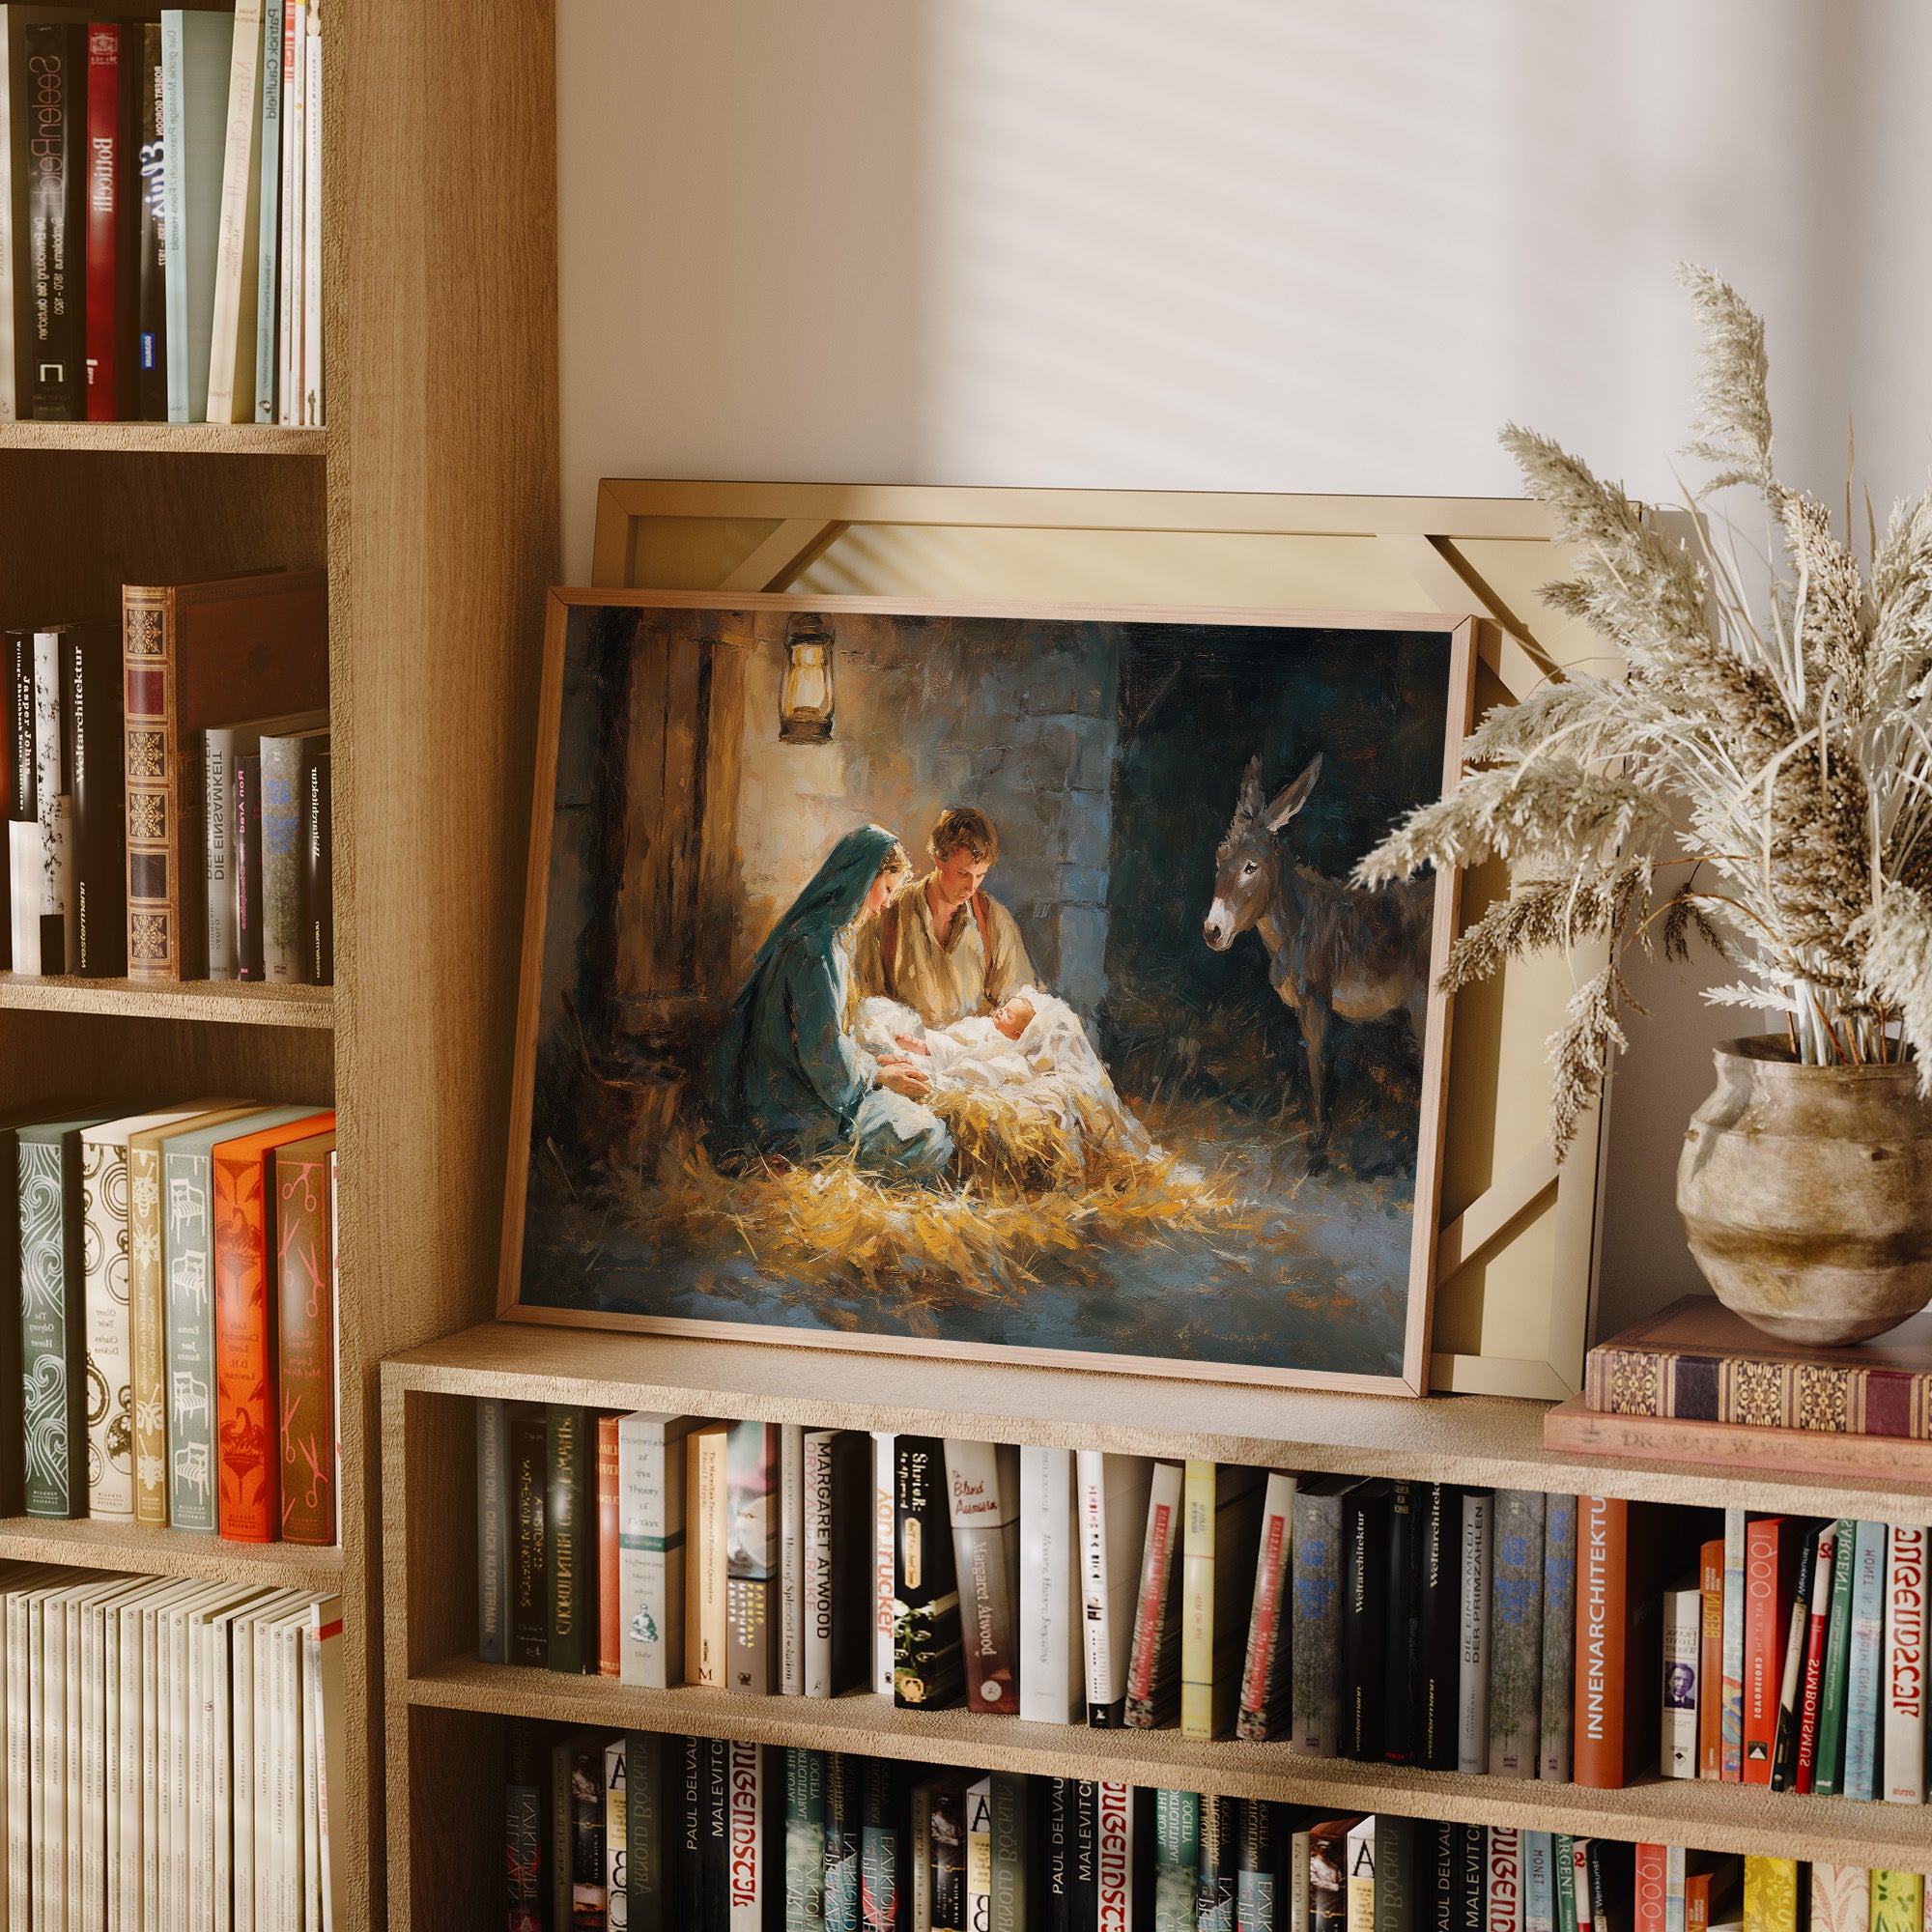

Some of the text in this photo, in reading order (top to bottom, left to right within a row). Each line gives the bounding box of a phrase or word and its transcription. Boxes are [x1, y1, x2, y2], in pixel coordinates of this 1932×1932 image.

[23, 676, 33, 776] Jasper Johns
[74, 645, 85, 783] Weltarchitektur
[485, 1406, 497, 1634] DOWNTOWN OWL CHUCK KLOSTERMAN
[629, 1484, 659, 1496] Theory
[806, 1441, 817, 1612] ORYX AND CRAKE
[816, 1442, 832, 1639] MARGARET ATWOOD
[953, 1480, 985, 1497] Blind
[972, 1541, 998, 1656] Margaret Atwood
[1354, 1510, 1365, 1614] Weltarchitektur
[1463, 1520, 1475, 1663] DIE EINSAMKEIT
[1471, 1505, 1484, 1663] DER PRIMZAHLEN
[1588, 1497, 1607, 1739] INNENARCHITEKTU
[1427, 1678, 1435, 1760] westermann
[686, 1736, 698, 1851] PAUL DELVAU
[1052, 1777, 1065, 1895] PAUL DELVAU
[1437, 1820, 1451, 1890] DELVAU
[1533, 1849, 1547, 1886] MONET
[1558, 1833, 1574, 1898] ARGENT
[1592, 1860, 1604, 1907] Werkkunst
[1635, 1856, 1662, 1918] 1900
